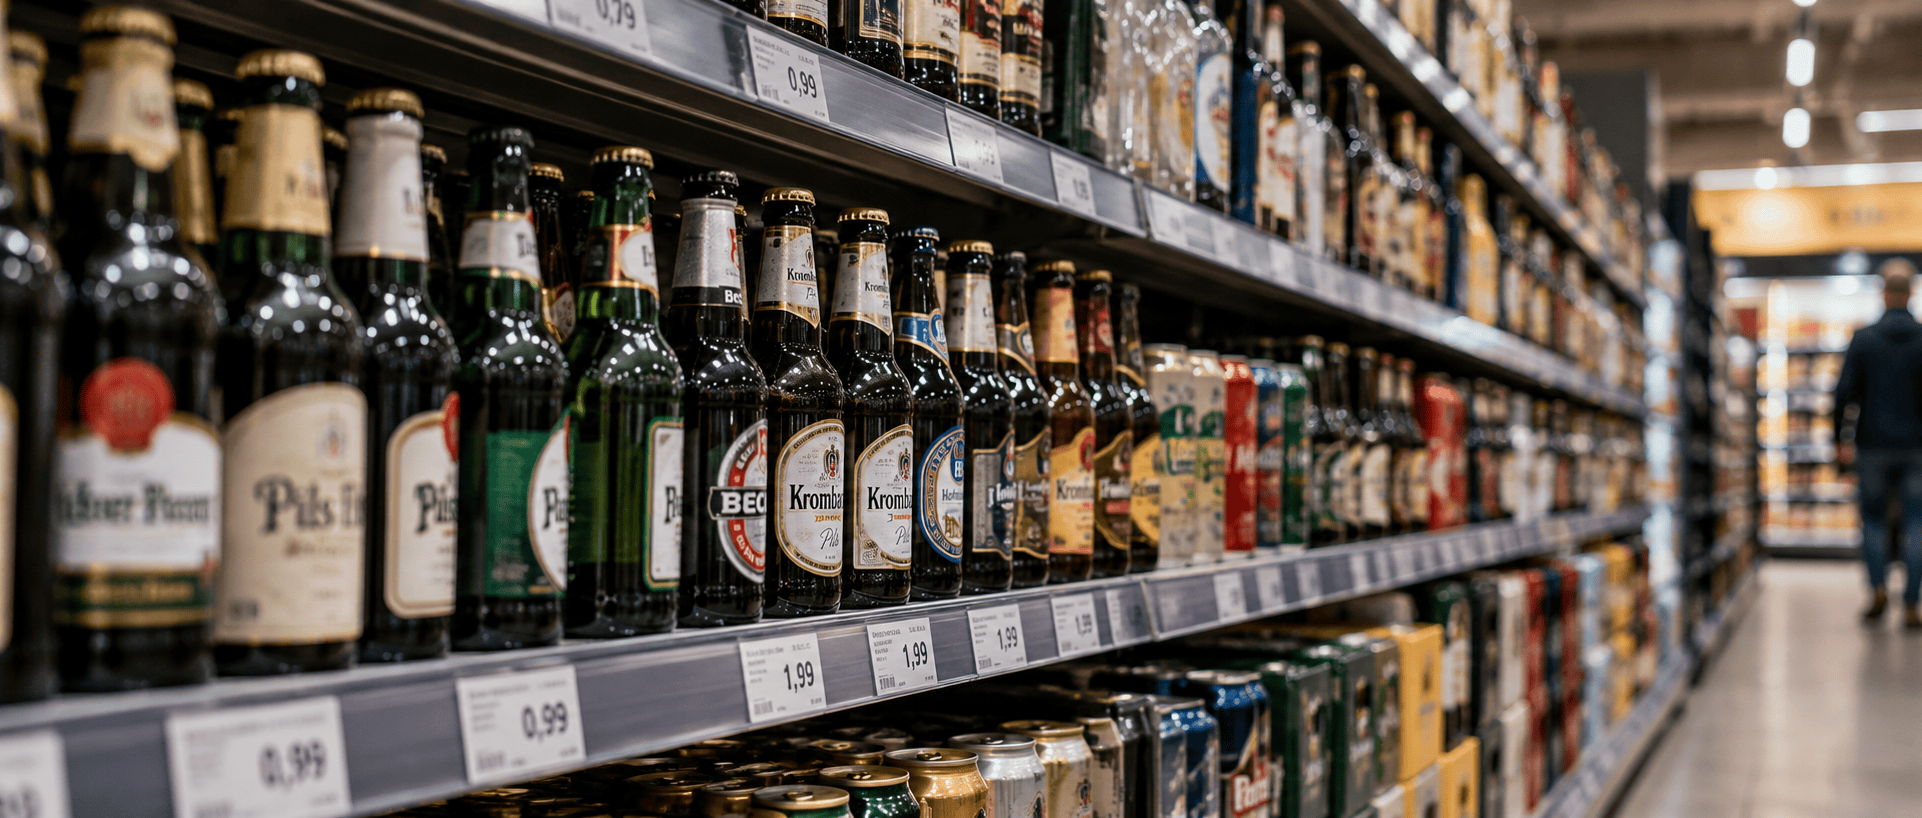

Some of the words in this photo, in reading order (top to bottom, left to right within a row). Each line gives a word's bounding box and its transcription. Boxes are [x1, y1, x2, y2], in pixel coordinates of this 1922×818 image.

[788, 66, 817, 98] 0,99
[789, 484, 844, 509] Kromba
[997, 626, 1018, 652] 1,99
[903, 641, 928, 671] 1,99
[783, 661, 815, 693] 1,99
[522, 702, 568, 742] 0,99
